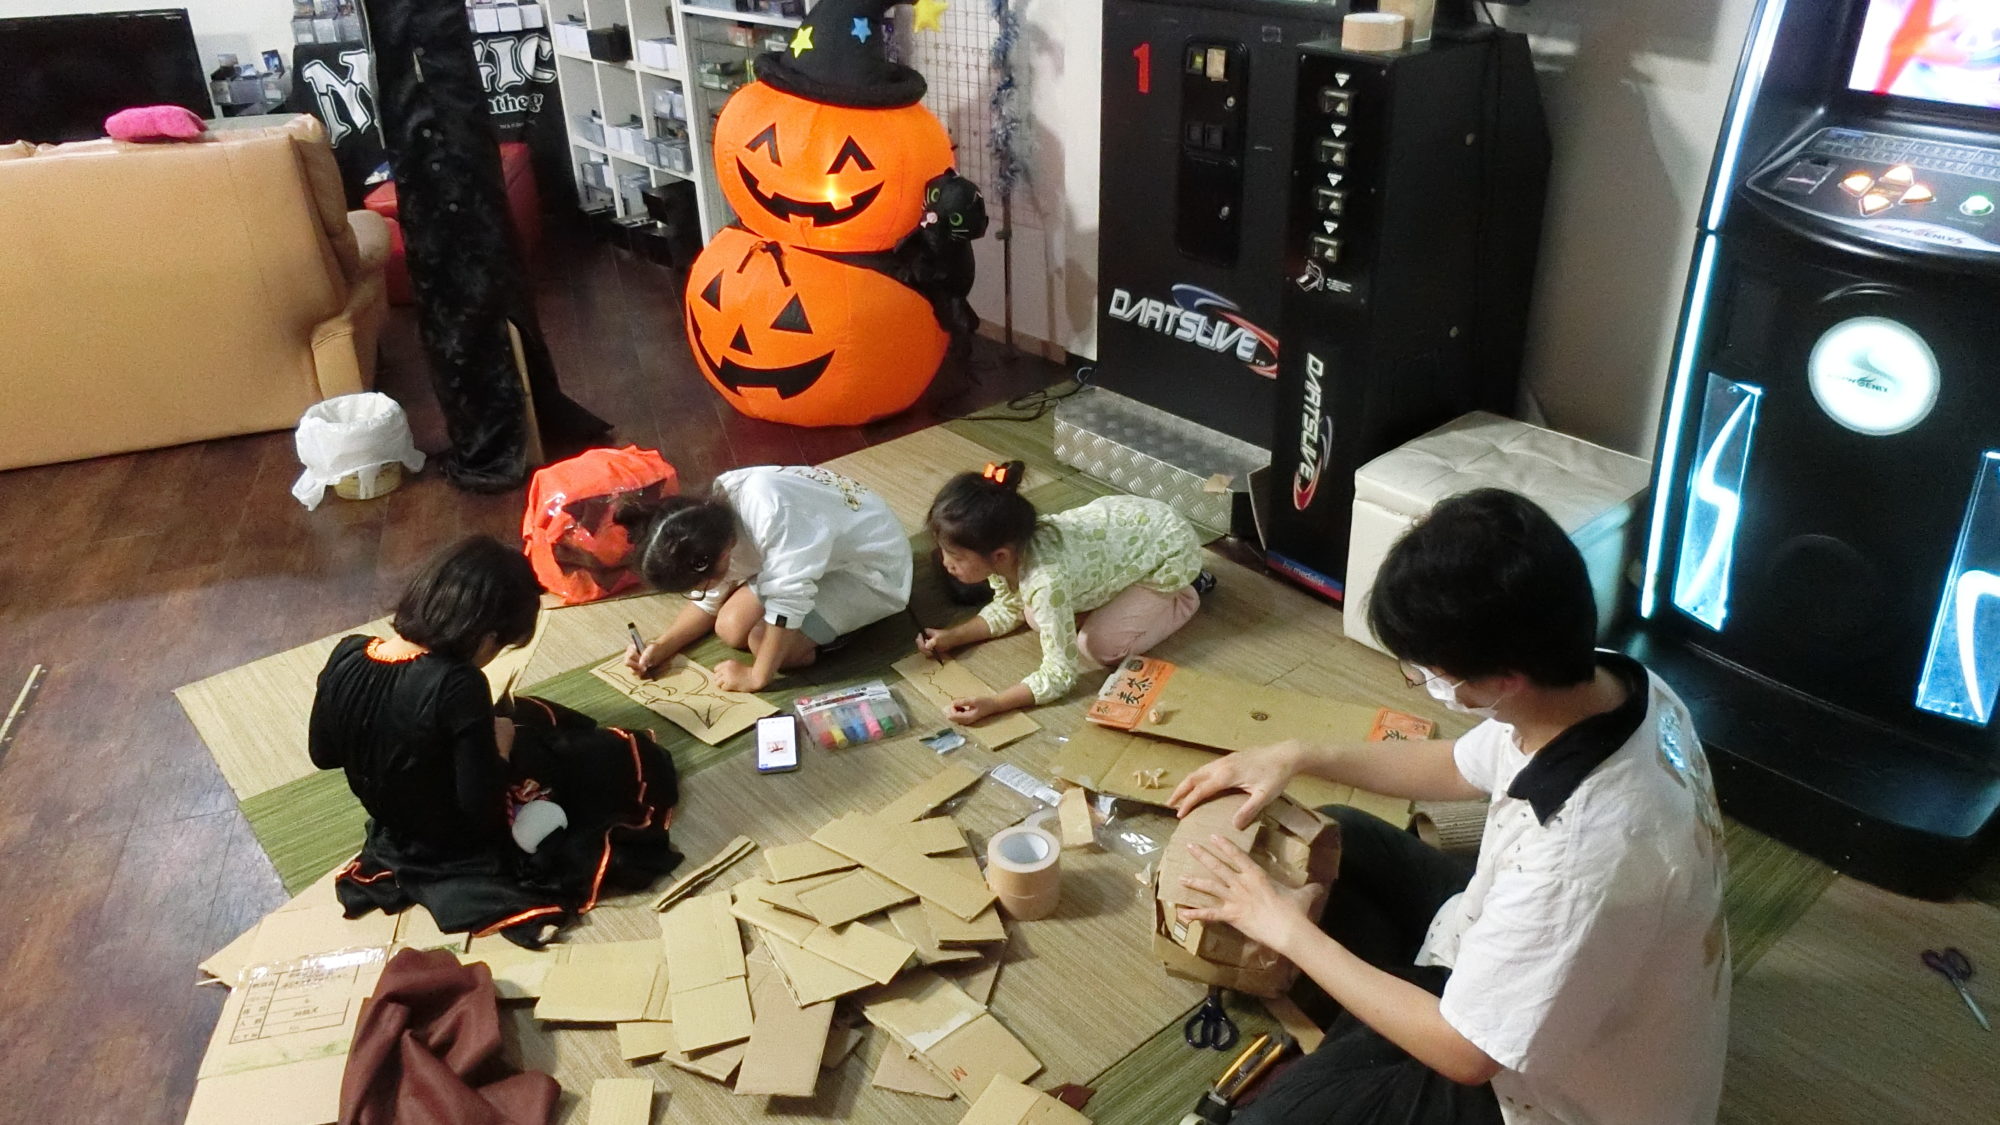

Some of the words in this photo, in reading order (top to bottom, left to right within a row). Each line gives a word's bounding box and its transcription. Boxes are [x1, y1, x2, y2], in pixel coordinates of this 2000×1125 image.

[1132, 42, 1151, 94] 1
[1109, 288, 1260, 363] DARTSLIVE
[1299, 352, 1324, 480] DARTSLIVE
